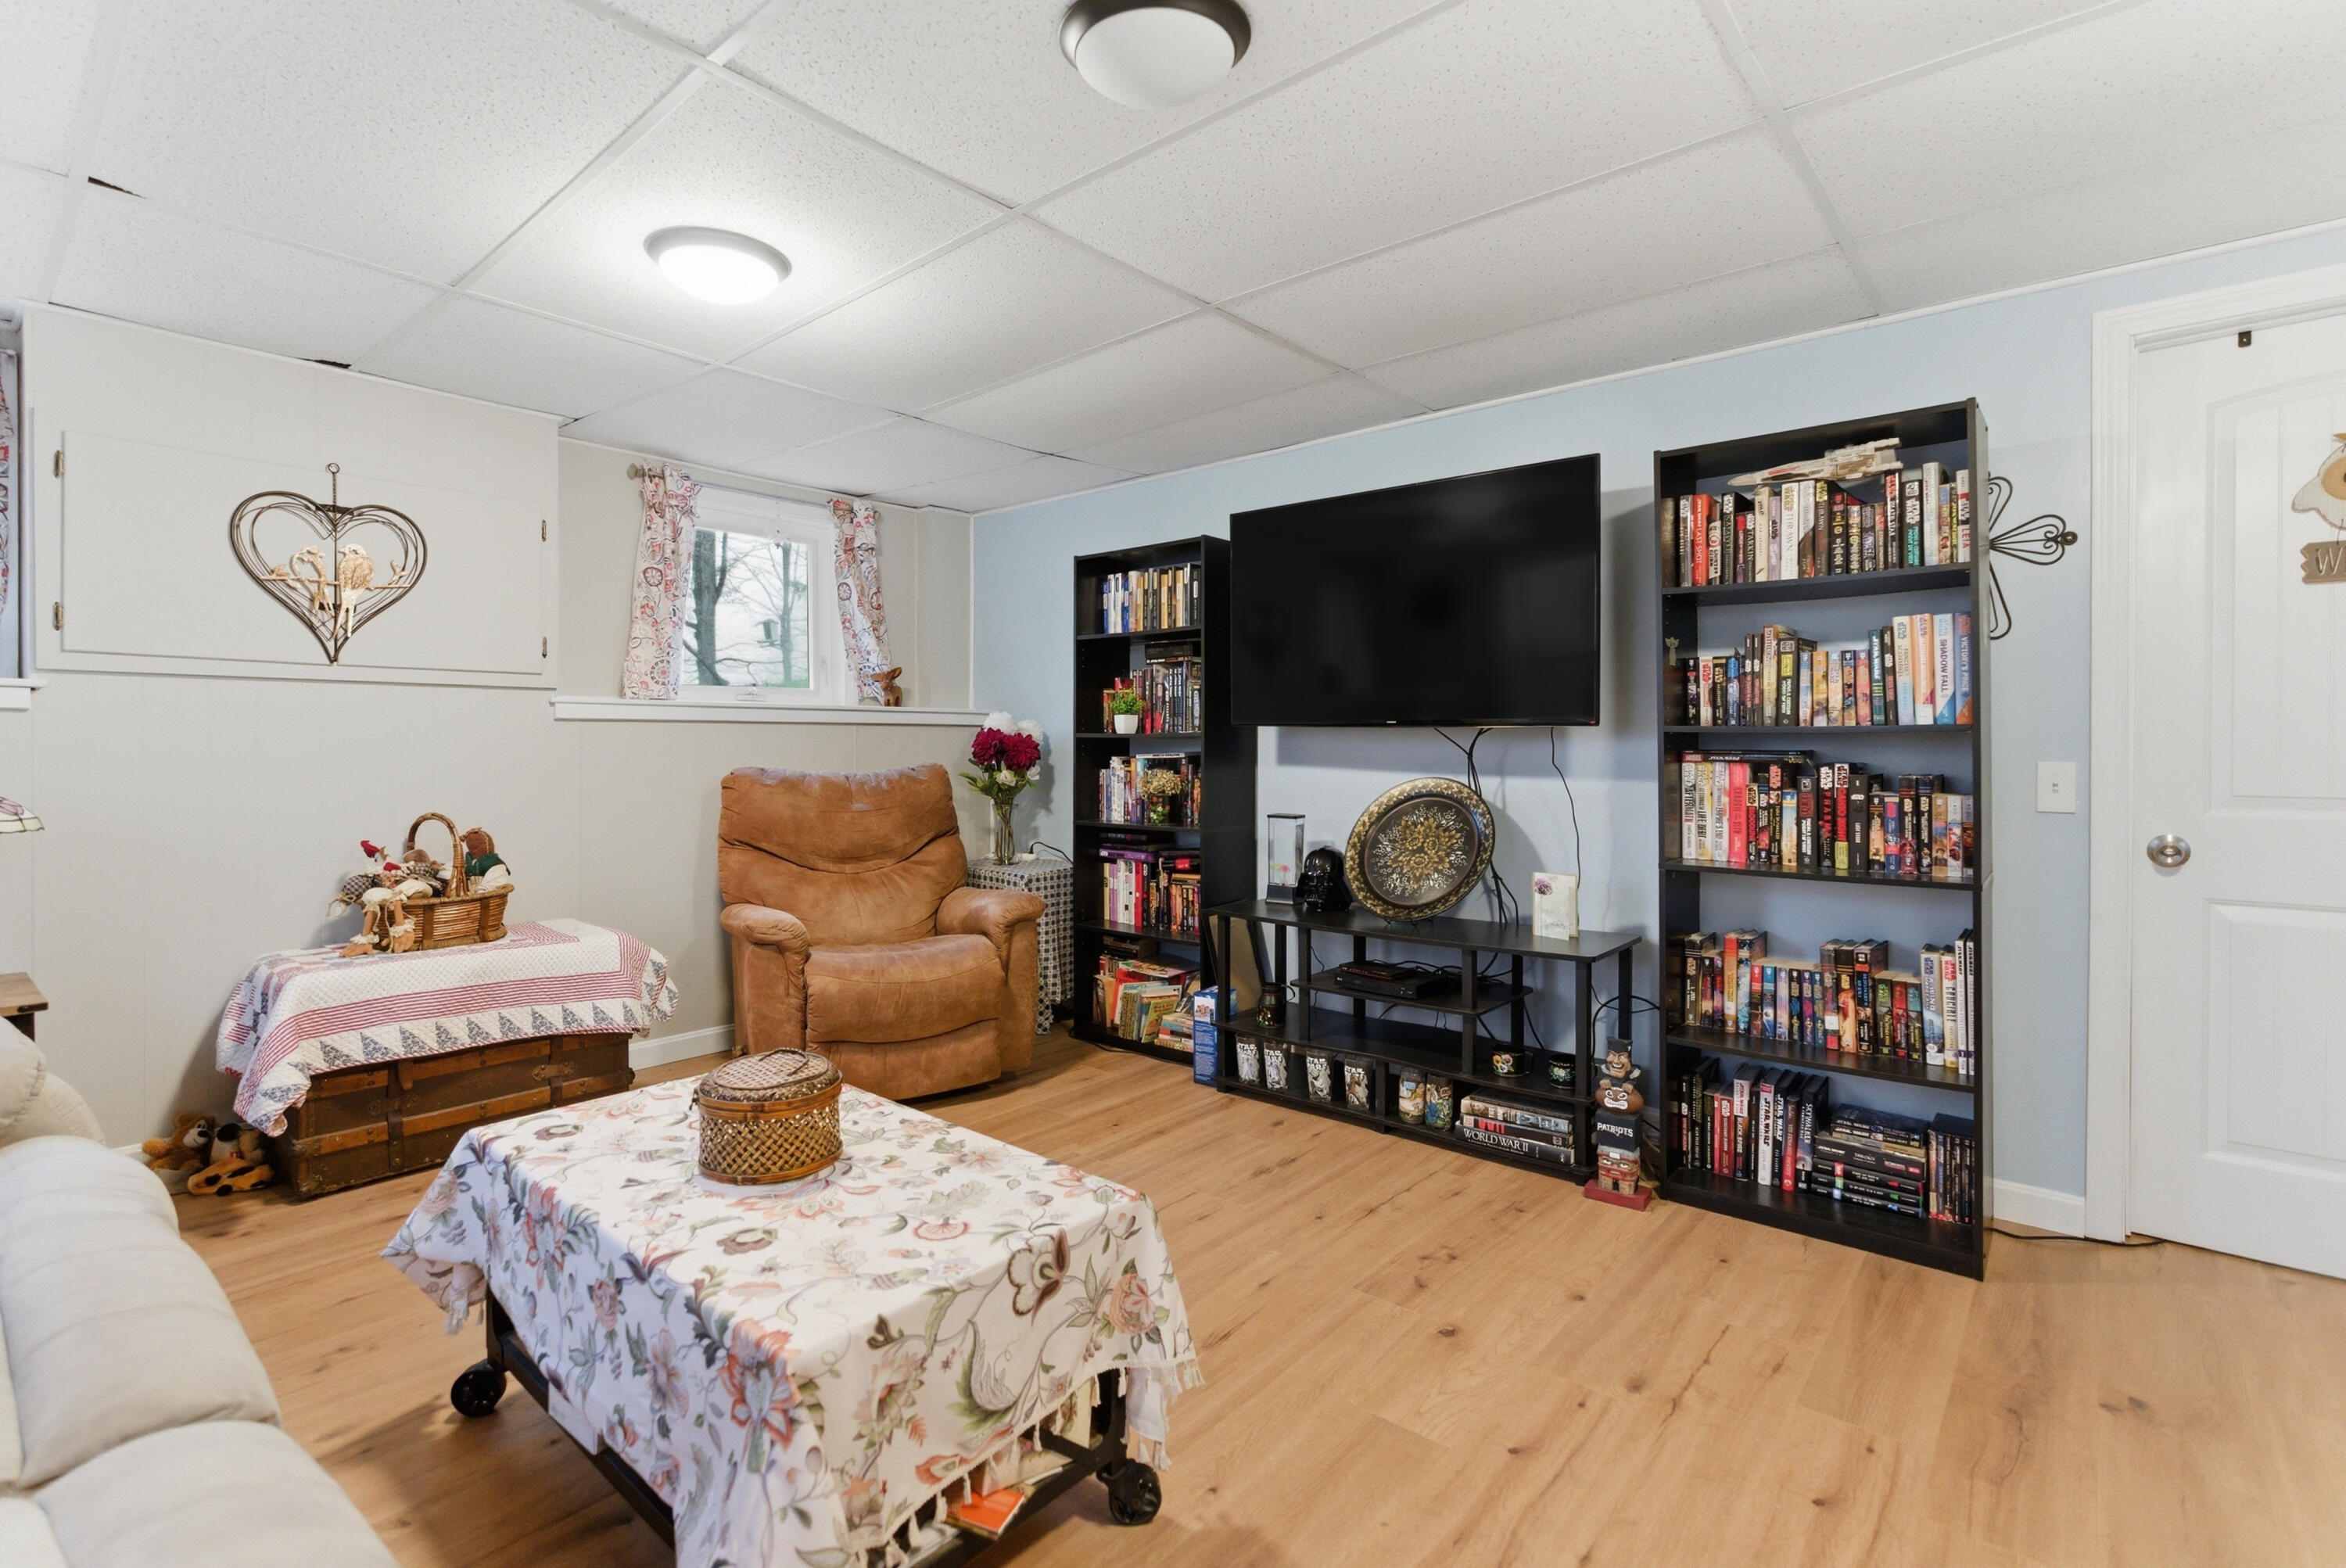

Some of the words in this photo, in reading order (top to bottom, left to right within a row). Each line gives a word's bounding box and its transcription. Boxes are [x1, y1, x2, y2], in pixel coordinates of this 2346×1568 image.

[1817, 502, 1827, 531] THRAWN
[1785, 513, 1795, 552] THRAWN
[1961, 528, 1971, 549] LEIA
[2316, 547, 2346, 576] W
[1939, 639, 1948, 673] SHADOW
[1960, 637, 1969, 671] VICTORY'S
[1940, 674, 1949, 693] FALL
[1961, 672, 1970, 692] PRICE
[1684, 788, 1694, 823] AFTERMATH
[1733, 787, 1743, 812] SHADOW
[1838, 788, 1847, 816] CANTO
[1697, 810, 1706, 823] LIFE
[1733, 821, 1743, 834] SITH
[1823, 791, 1832, 838] PHASMA
[1697, 823, 1707, 839] DEBT
[1837, 816, 1846, 841] BIGHT
[1945, 986, 1957, 1023] CRUCIBLE
[1344, 1065, 1365, 1075] STAR
[1597, 1121, 1634, 1138] PATRIOTS
[1803, 1103, 1813, 1144] SKYWALKER
[1463, 1127, 1498, 1145] WORLD
[1498, 1136, 1523, 1151] WAR
[1522, 1143, 1529, 1153] II
